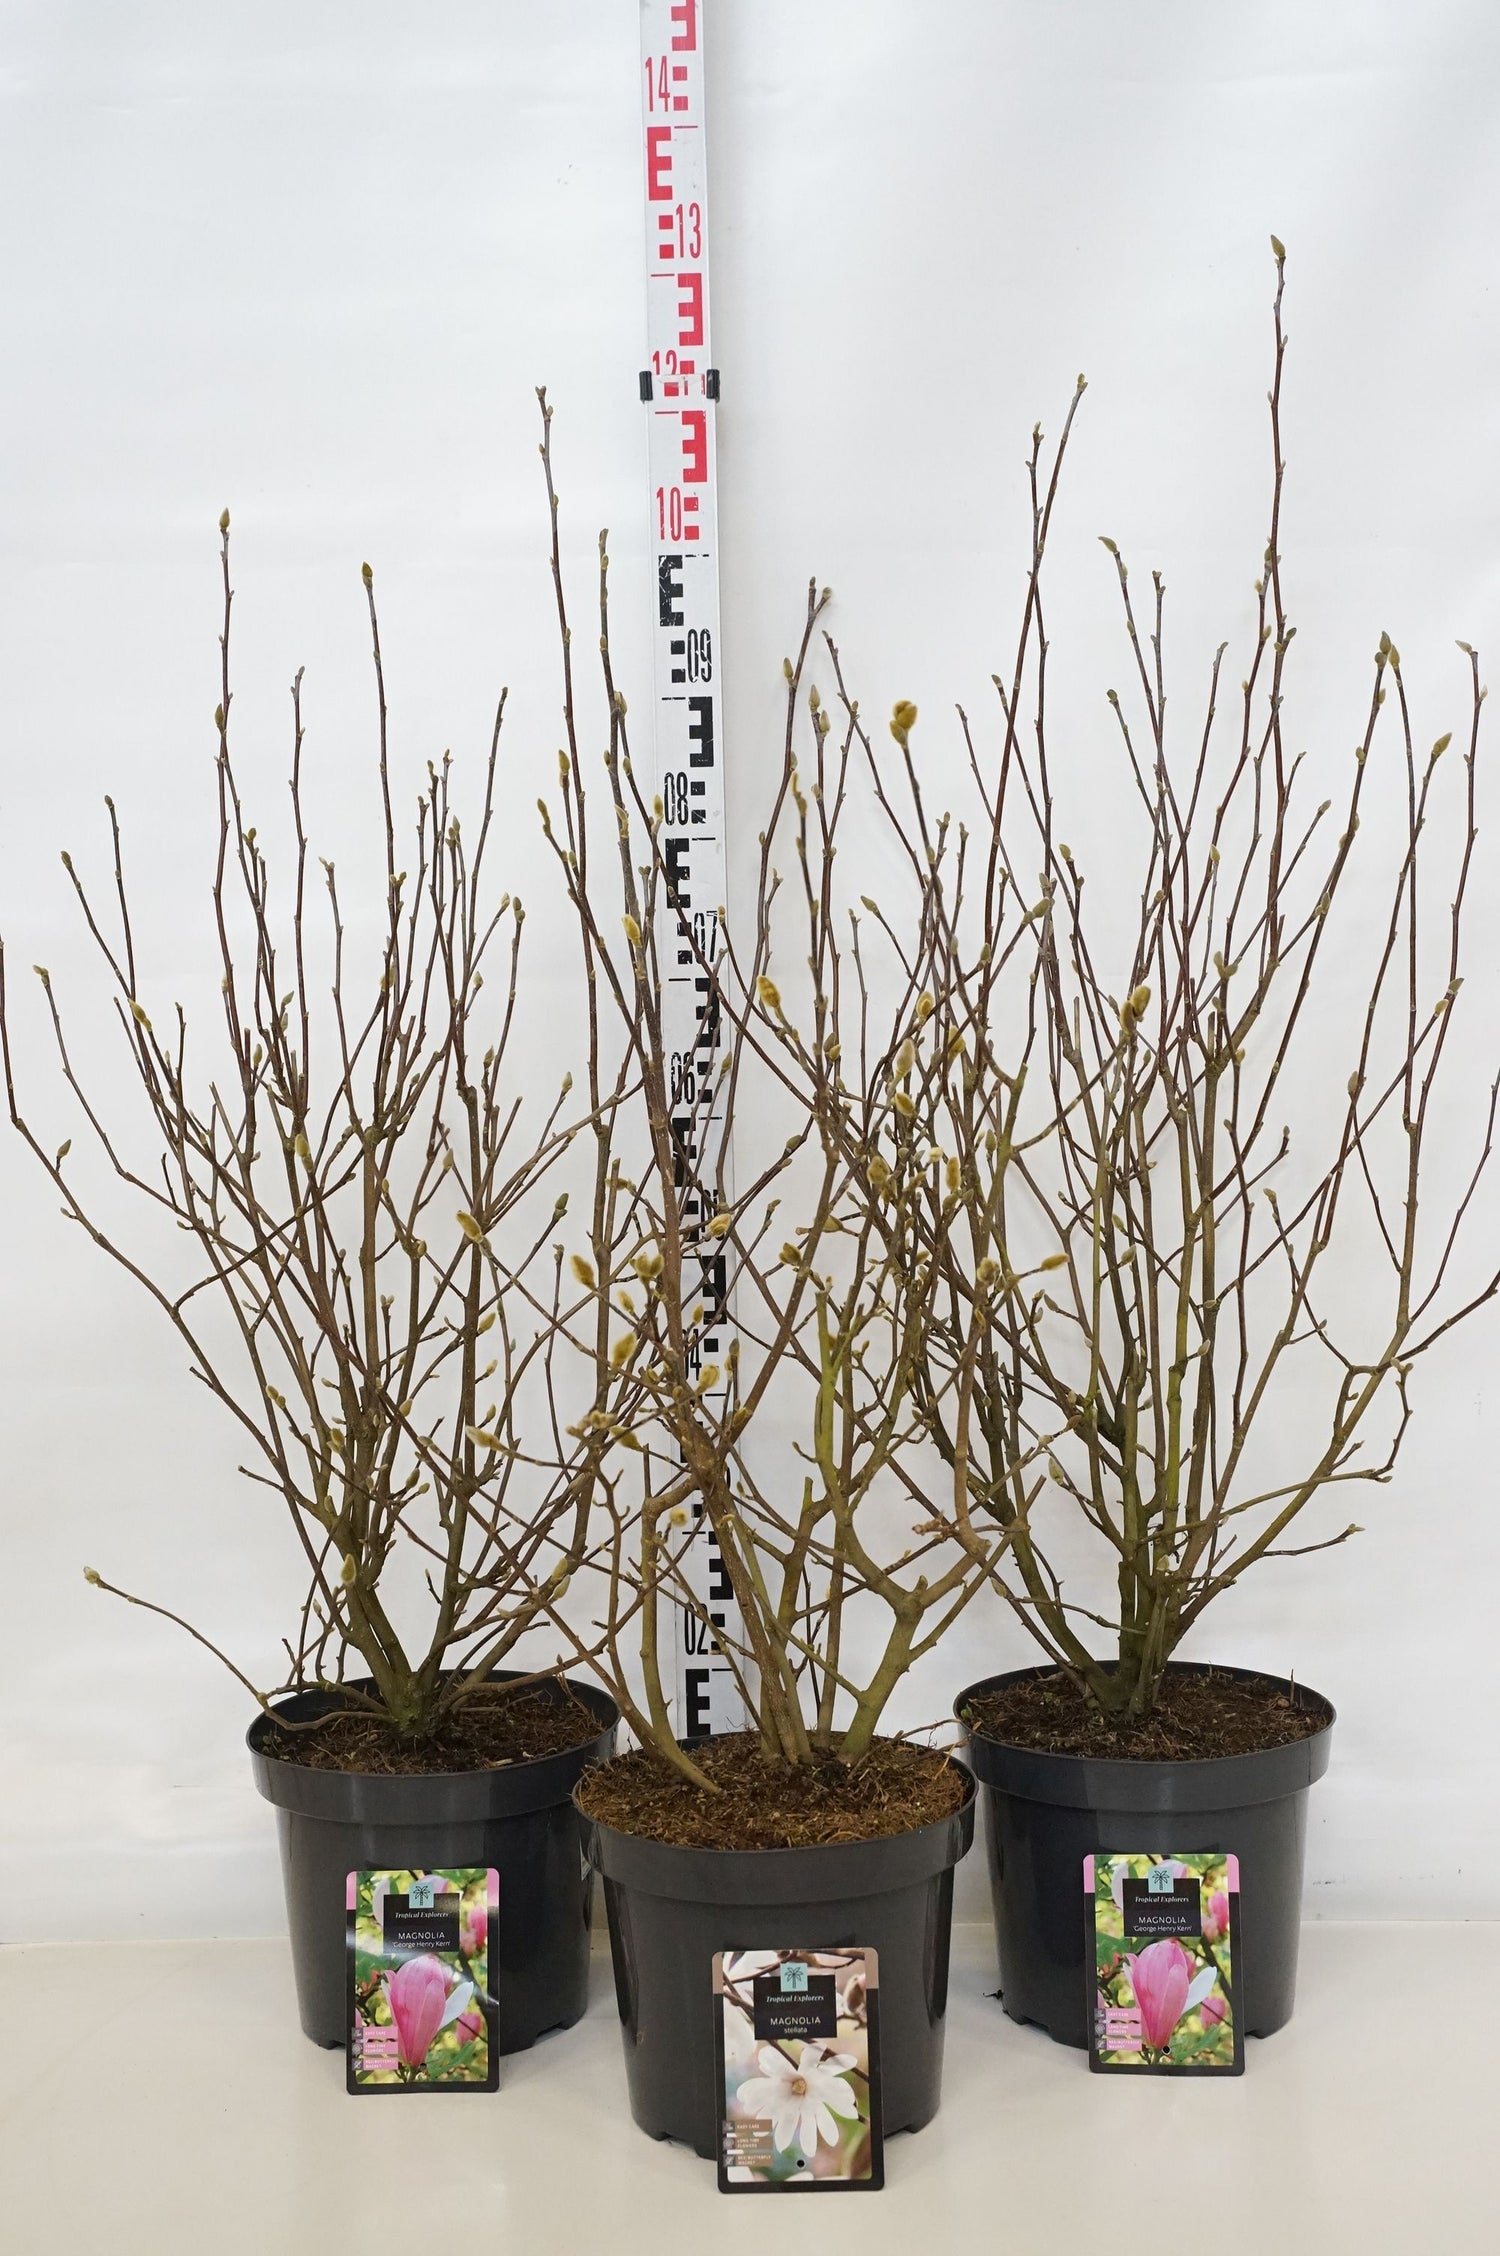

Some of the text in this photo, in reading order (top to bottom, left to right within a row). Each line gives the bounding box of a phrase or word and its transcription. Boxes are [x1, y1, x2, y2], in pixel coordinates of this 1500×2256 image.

[645, 55, 670, 112] 14
[676, 203, 701, 259] 13
[656, 486, 682, 541] 10
[687, 629, 713, 683] 09
[663, 772, 688, 826] 08
[694, 910, 718, 964] 07
[671, 1051, 696, 1105] 06
[685, 1603, 710, 1656] 02
[398, 1932, 445, 1940] MAGNOLIA
[1138, 1916, 1187, 1924] MAGNOLIA
[1157, 1925, 1177, 1933] Henry
[766, 1994, 824, 2003] Tropical Explorers
[770, 2016, 821, 2026] MAGNOLIA
